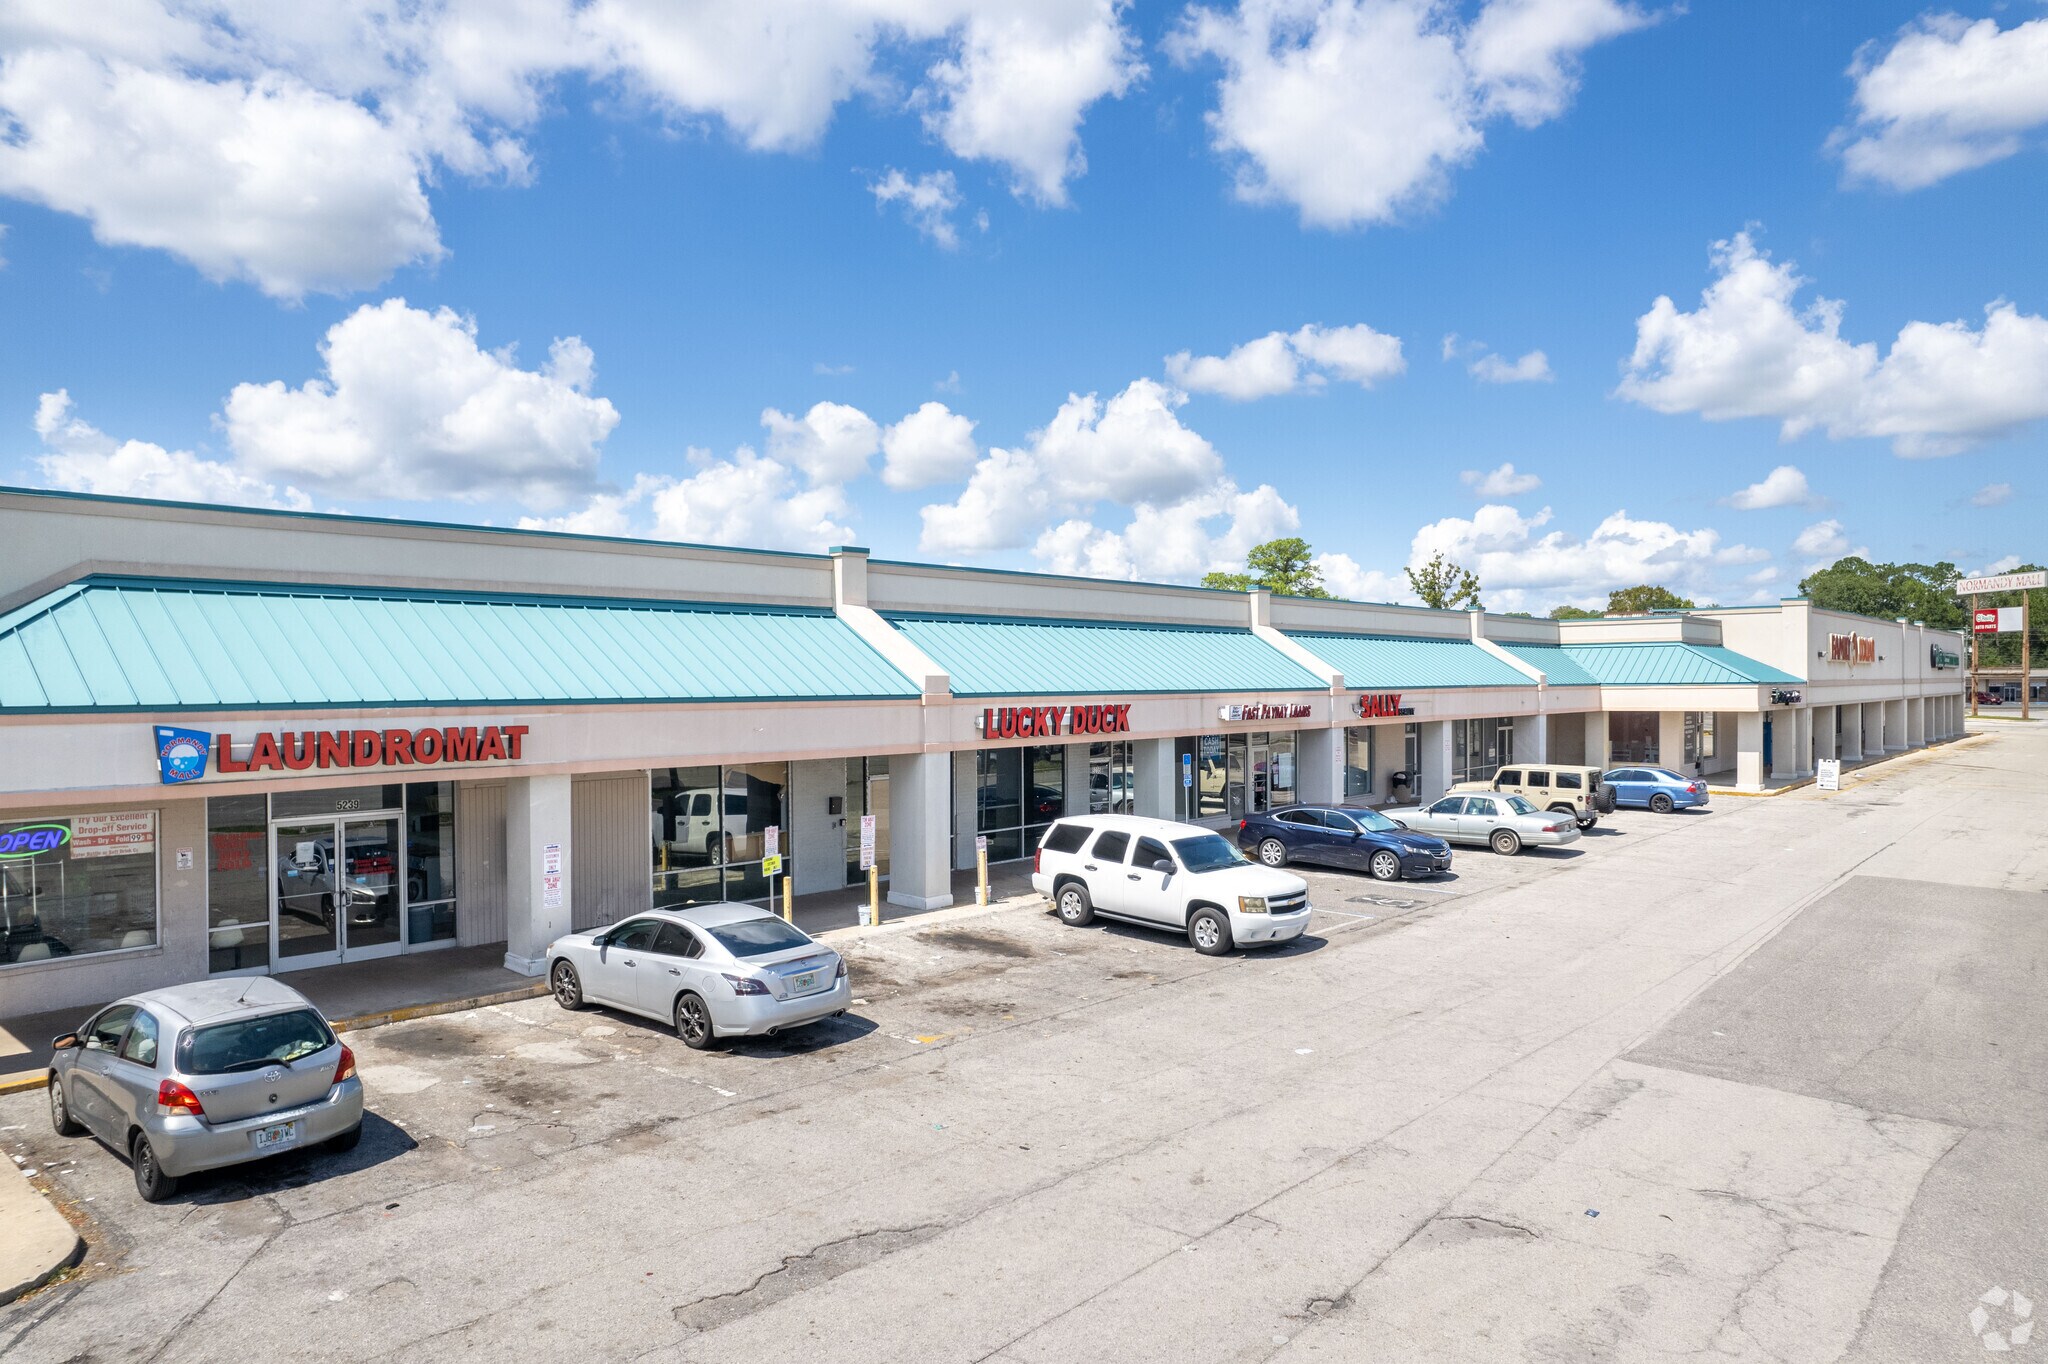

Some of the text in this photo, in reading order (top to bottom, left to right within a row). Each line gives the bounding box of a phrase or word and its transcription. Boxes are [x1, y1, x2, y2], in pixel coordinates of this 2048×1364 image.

[1959, 573, 2043, 592] NORMANDY MALL
[1360, 694, 1402, 718] SALLY
[983, 704, 1132, 739] LUCKY DUCK
[161, 737, 207, 757] NORMANDY
[216, 725, 530, 773] LAUNDROMAT
[1204, 737, 1219, 746] CASH
[168, 768, 200, 779] MALL
[336, 800, 360, 811] 5239
[78, 823, 147, 834] Drop-off Service
[0, 830, 63, 852] OPEN
[73, 838, 91, 846] Wash
[115, 835, 129, 843] Fold
